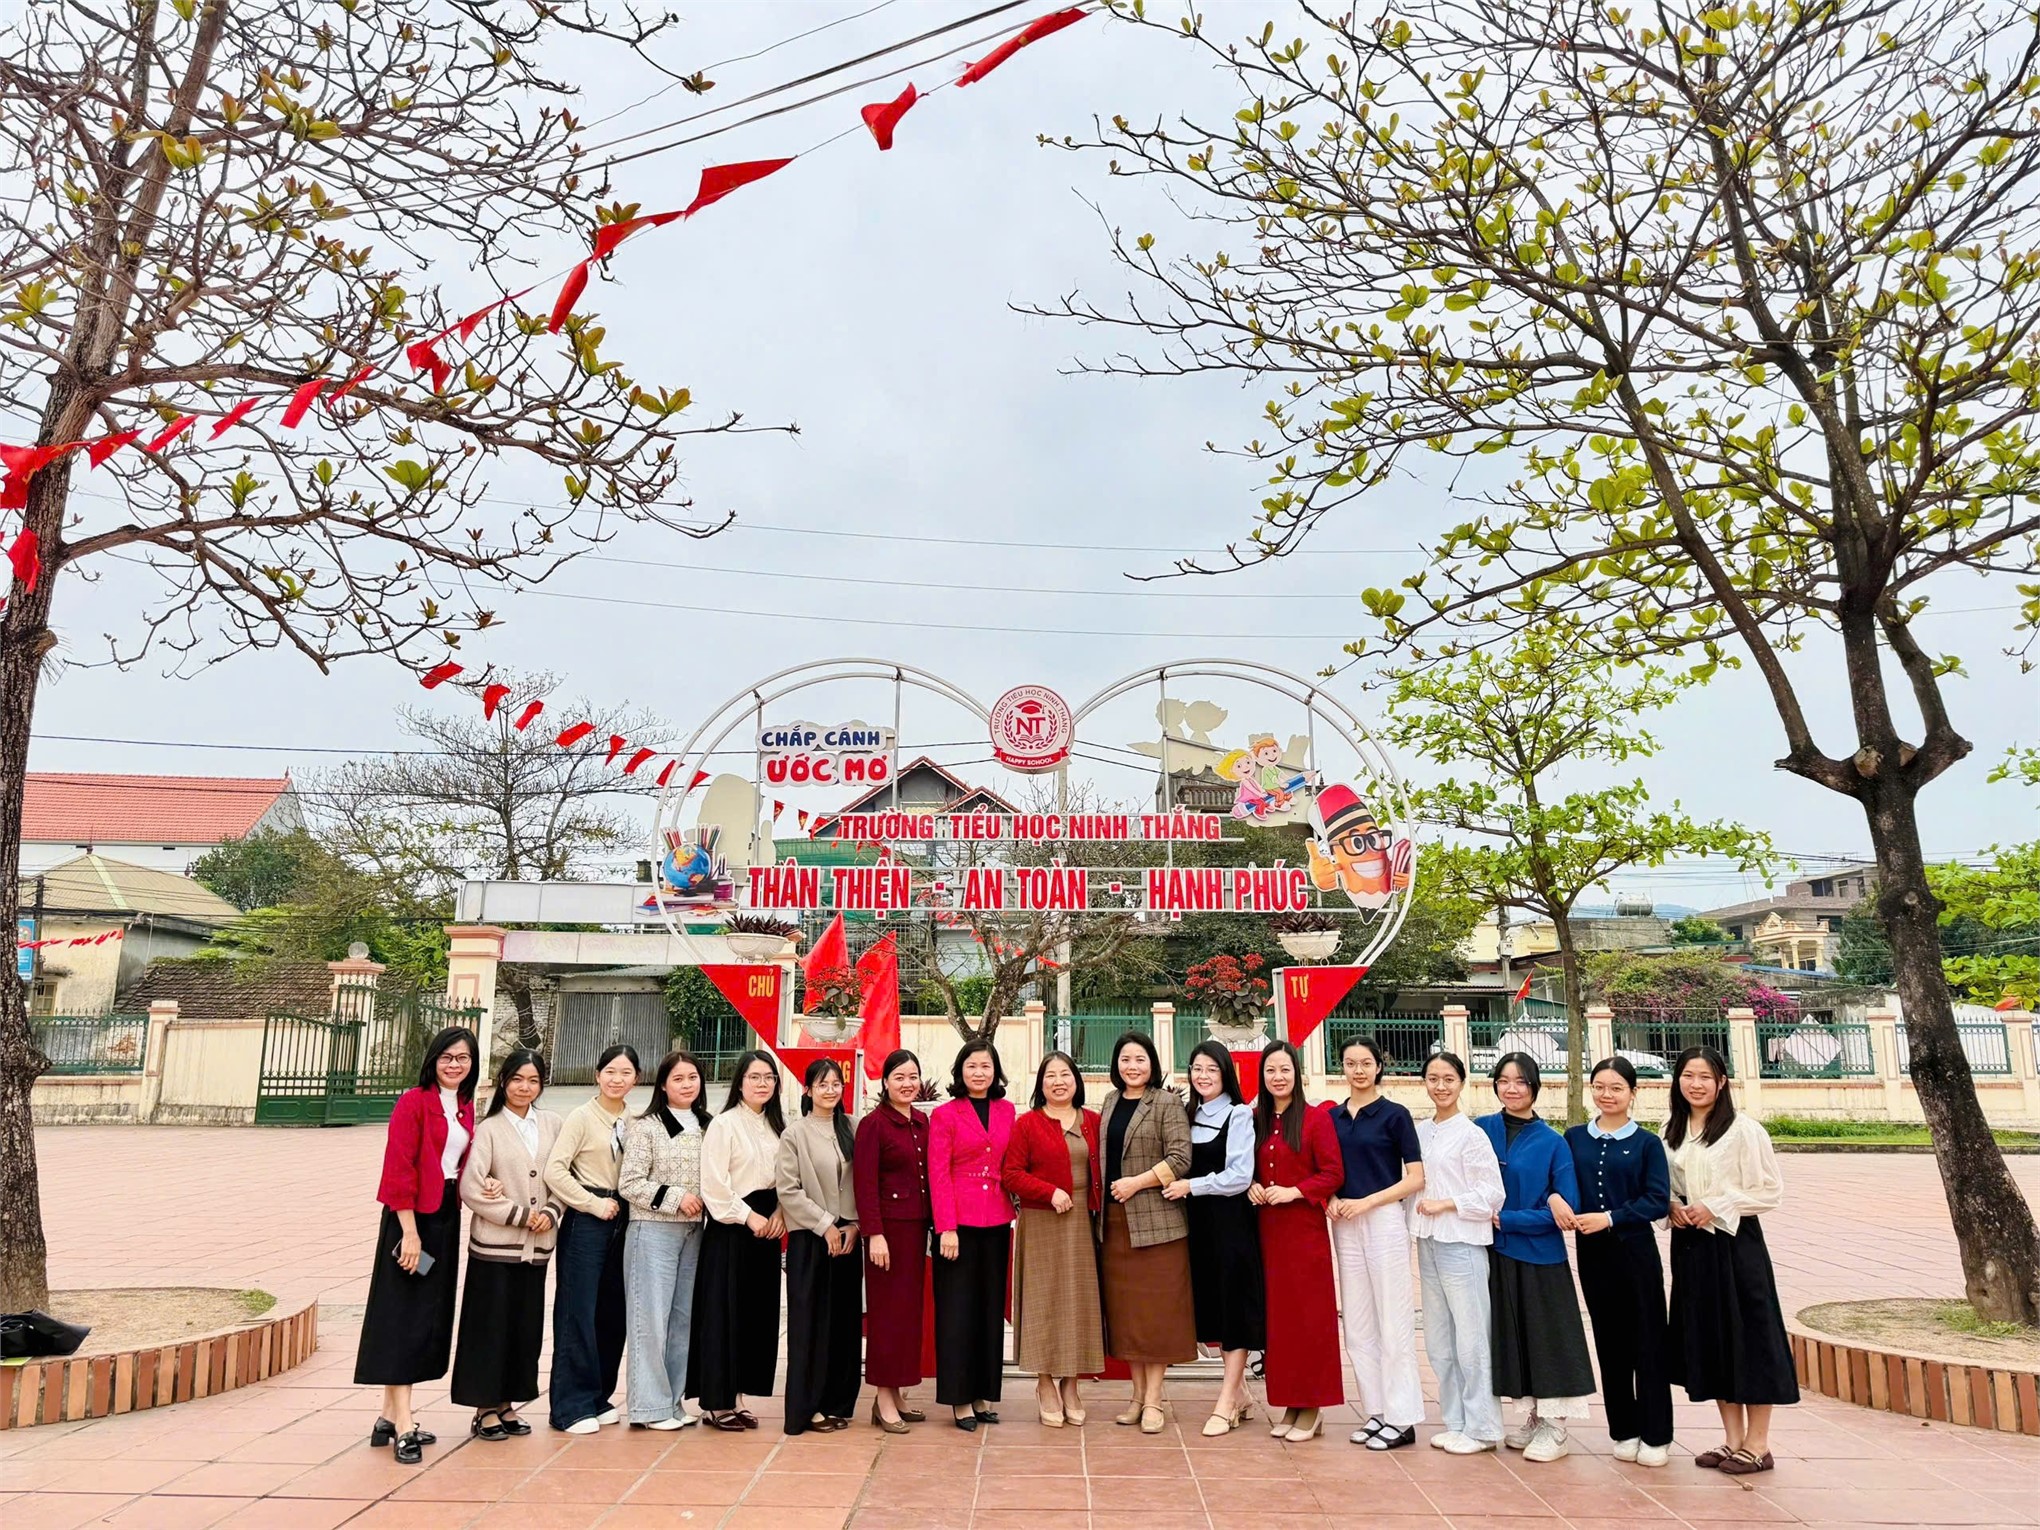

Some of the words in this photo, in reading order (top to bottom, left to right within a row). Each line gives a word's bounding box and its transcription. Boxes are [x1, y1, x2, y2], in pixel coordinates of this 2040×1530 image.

[1043, 692, 1060, 708] NINH
[761, 725, 817, 747] CHẮP
[824, 727, 880, 746] CÁNH
[1015, 716, 1047, 736] NT
[767, 753, 832, 783] ƯỚC
[844, 755, 888, 781] MƠ
[1005, 756, 1026, 765] HAPPY
[1027, 757, 1053, 766] SCHOOL
[841, 806, 934, 839] TRƯỜNG
[950, 804, 1002, 839] TIỂU
[1013, 814, 1061, 845] HỌC
[1069, 814, 1128, 839] NINH
[1141, 806, 1220, 839] THẮNG
[748, 858, 819, 908] THÂN
[832, 858, 910, 918] THIỆN
[963, 868, 1003, 910] AN
[1016, 859, 1087, 910] TOÀN
[1149, 868, 1223, 919] HẠNH
[1234, 860, 1306, 911] PHÚC
[748, 968, 775, 998] CHỦ
[1290, 974, 1309, 1003] TỰ
